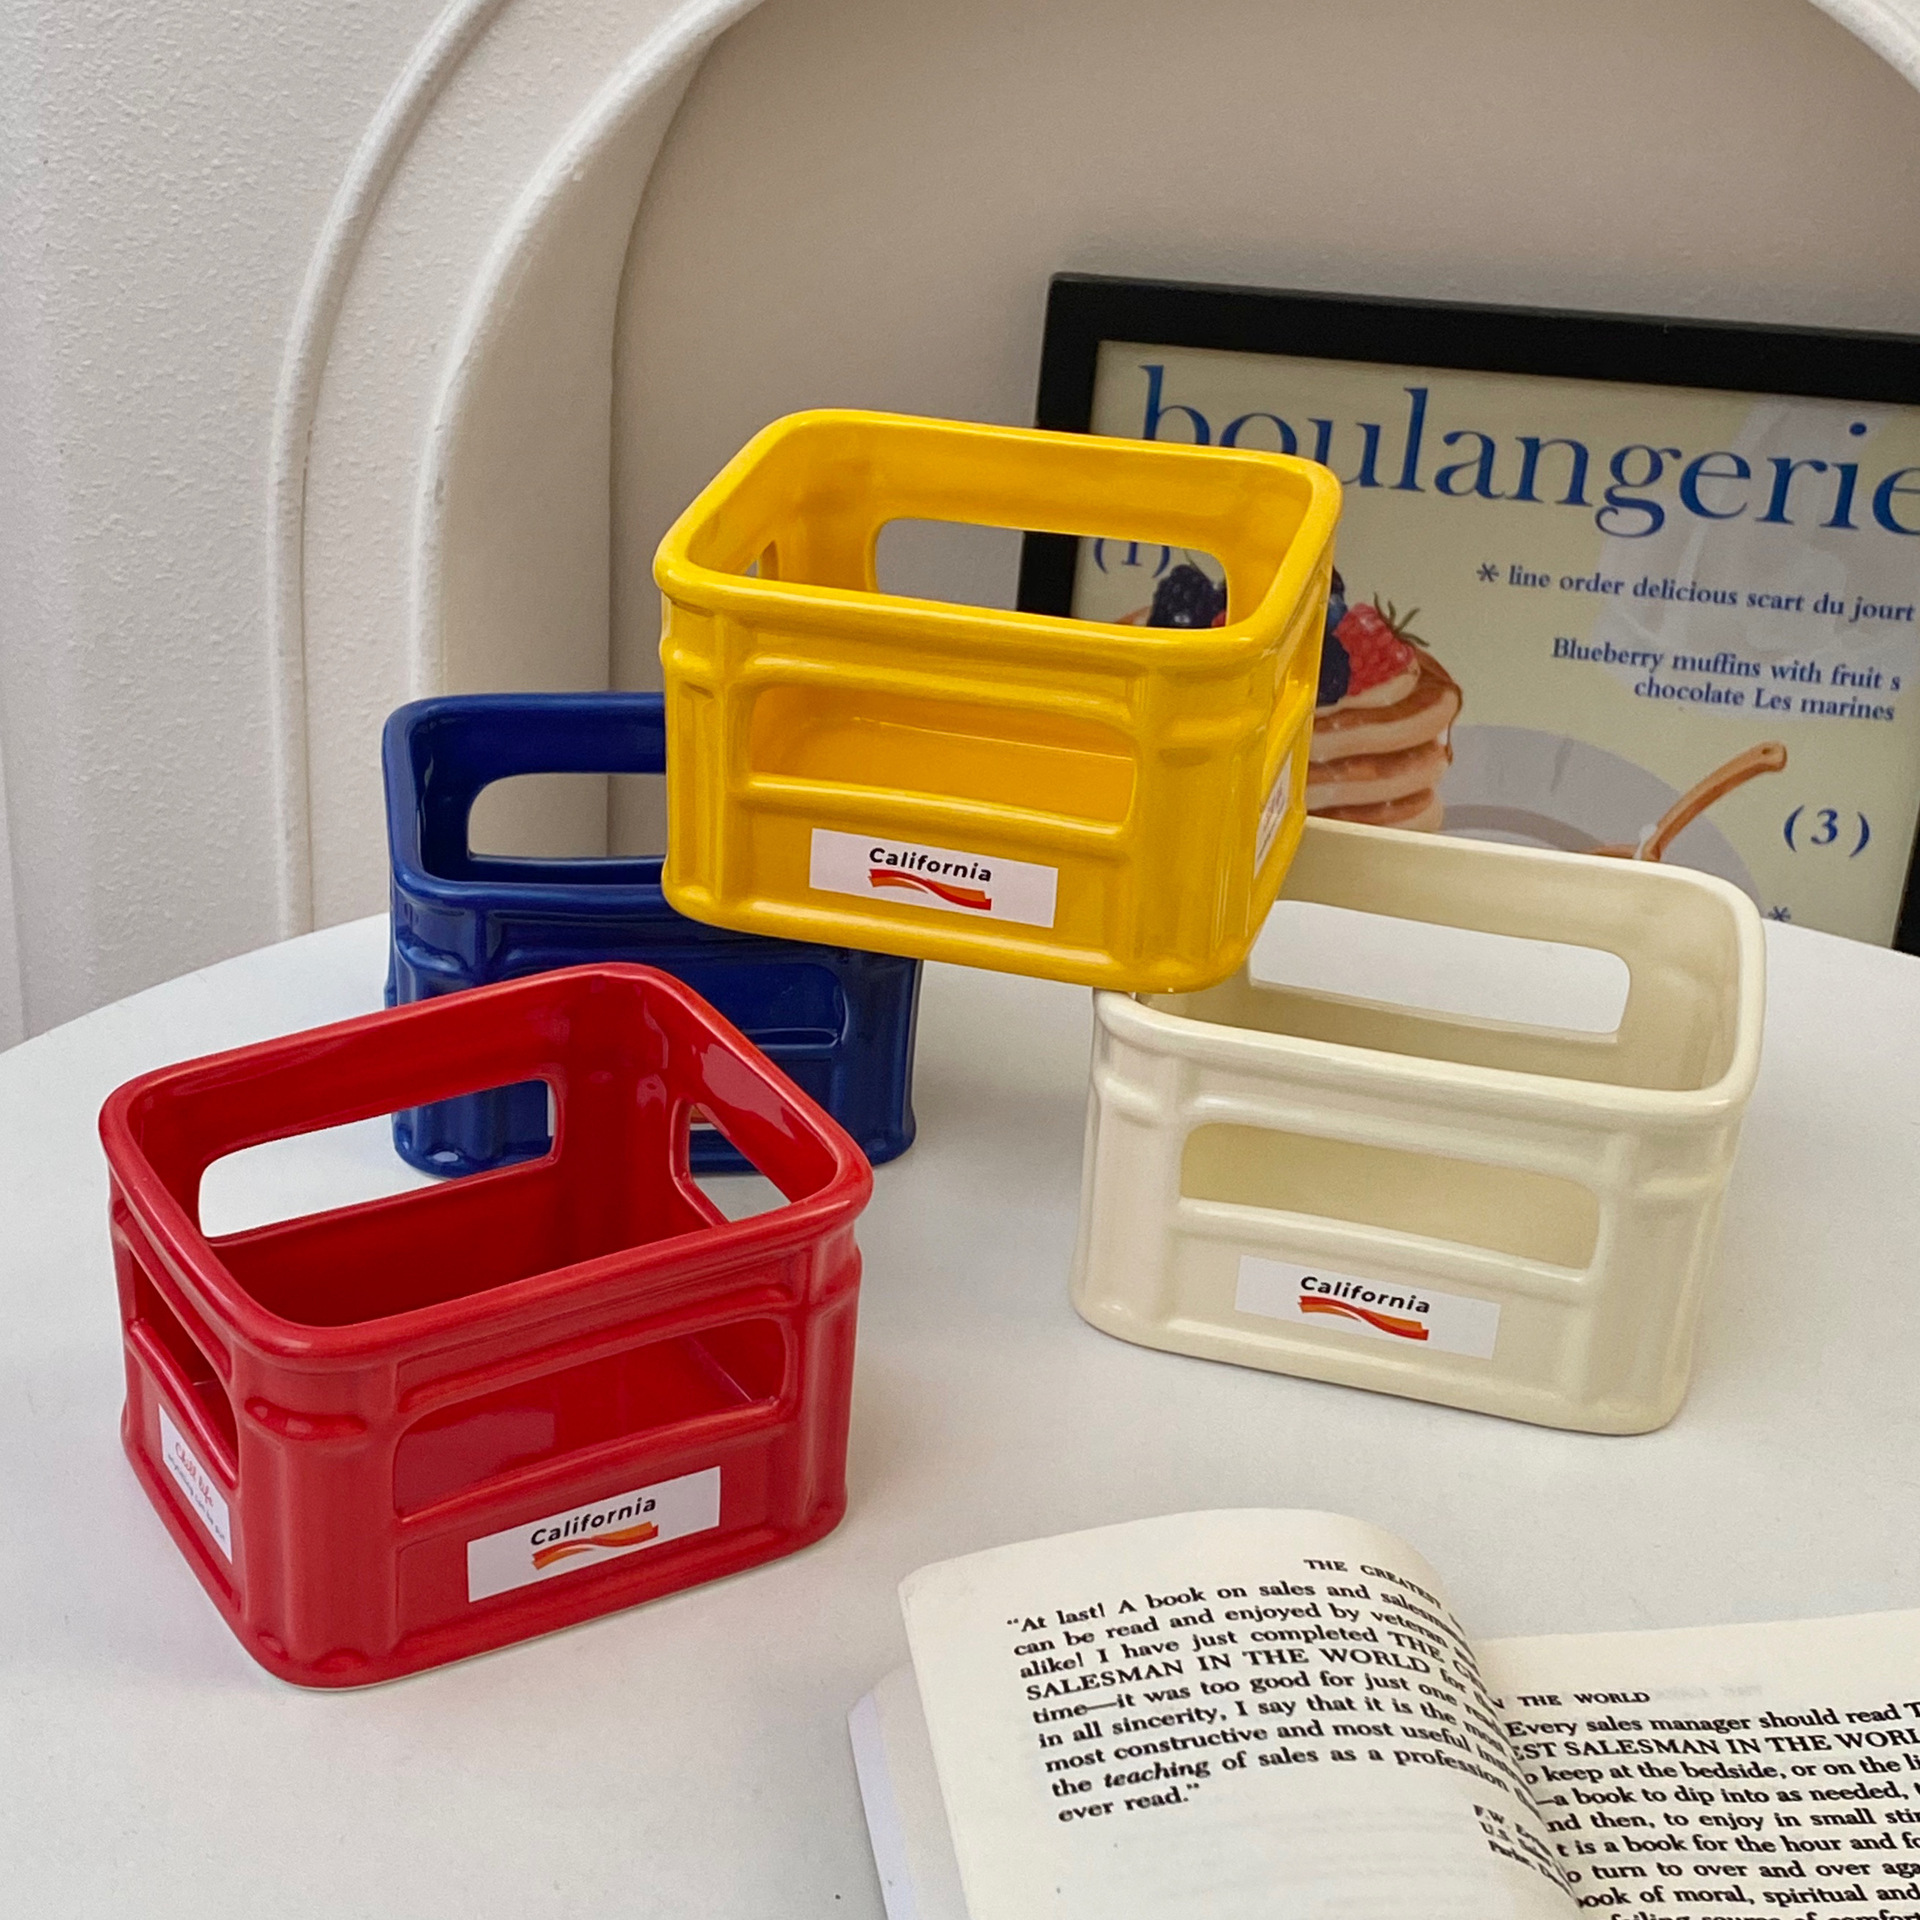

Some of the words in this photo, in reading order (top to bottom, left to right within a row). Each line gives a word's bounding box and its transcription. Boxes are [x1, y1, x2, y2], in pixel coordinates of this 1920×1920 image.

[1139, 365, 1920, 538] boulangerie
[1509, 565, 1550, 588] line
[1559, 572, 1625, 595] order
[1633, 577, 1737, 605] delicious
[1747, 594, 1804, 612] scart
[1813, 592, 1844, 615] du
[1849, 596, 1914, 623] jourt
[1553, 638, 1663, 674] Blueberry
[1672, 653, 1760, 677] muffins
[1771, 660, 1821, 683] with
[1831, 664, 1882, 689] fruit
[1890, 677, 1900, 691] s
[1634, 676, 1744, 705] chocolate
[1755, 688, 1791, 710] Les
[1801, 696, 1894, 720] marines
[869, 848, 991, 882] California
[1301, 1276, 1430, 1313] California
[530, 1497, 657, 1546] California
[1303, 1559, 1348, 1572] THE
[1056, 1603, 1105, 1625] last!
[1118, 1600, 1137, 1614] A
[1145, 1587, 1206, 1609] book
[1217, 1588, 1247, 1599] on
[1259, 1581, 1316, 1596] sales
[1327, 1584, 1371, 1599] and
[1014, 1640, 1055, 1656] can
[1063, 1631, 1094, 1646] be
[1106, 1616, 1159, 1638] read
[1170, 1608, 1215, 1628] and
[1225, 1602, 1322, 1622] enjoyed
[1328, 1603, 1359, 1622] by
[1020, 1652, 1083, 1678] alike!
[1097, 1649, 1109, 1663] I
[1121, 1642, 1179, 1658] have
[1193, 1631, 1237, 1652] just
[1251, 1624, 1379, 1643] completed
[1387, 1631, 1445, 1663] THE
[1026, 1659, 1184, 1700] SALESMAN
[1197, 1653, 1231, 1671] IN
[1242, 1649, 1309, 1665] THE
[1319, 1648, 1430, 1673] WORLD
[1440, 1668, 1466, 1693] for
[1143, 1687, 1190, 1703] was
[1200, 1681, 1240, 1695] too
[1250, 1671, 1311, 1693] good
[1320, 1670, 1354, 1686] for
[1365, 1673, 1410, 1691] just
[1418, 1684, 1457, 1706] one
[1517, 1695, 1562, 1707] THE
[1573, 1692, 1650, 1704] WORLD
[1039, 1734, 1063, 1748] in
[1073, 1721, 1103, 1741] all
[1112, 1708, 1226, 1735] sincerity,
[1235, 1701, 1248, 1716] I
[1258, 1701, 1296, 1716] say
[1307, 1694, 1356, 1711] that
[1365, 1696, 1384, 1711] it
[1392, 1698, 1413, 1714] is
[1420, 1702, 1457, 1725] the
[1504, 1721, 1577, 1737] Every
[1586, 1715, 1643, 1732] sales
[1649, 1719, 1751, 1734] manager
[1759, 1708, 1840, 1728] should
[1845, 1703, 1902, 1723] read
[1045, 1749, 1105, 1772] most
[1112, 1723, 1267, 1760] constructive
[1277, 1719, 1324, 1738] and
[1332, 1723, 1394, 1736] most
[1401, 1726, 1471, 1752] useful
[1564, 1739, 1720, 1756] SALESMAN
[1725, 1738, 1761, 1754] IN
[1764, 1735, 1832, 1752] THE
[1834, 1728, 1920, 1749] WORL
[1052, 1779, 1092, 1797] the
[1104, 1761, 1211, 1789] teaching
[1222, 1750, 1246, 1770] of
[1258, 1746, 1319, 1766] sales
[1330, 1750, 1357, 1761] as
[1368, 1749, 1384, 1761] a
[1393, 1749, 1509, 1792] profession
[1541, 1765, 1603, 1783] keep
[1609, 1765, 1634, 1778] at
[1637, 1761, 1678, 1778] the
[1679, 1761, 1787, 1779] bedside,
[1791, 1765, 1817, 1776] or
[1823, 1764, 1856, 1775] on
[1859, 1756, 1901, 1773] the
[1571, 1786, 1637, 1804] book
[1641, 1789, 1667, 1802] to
[1674, 1785, 1715, 1806] dip
[1720, 1788, 1770, 1803] into
[1776, 1790, 1803, 1802] as
[1809, 1781, 1909, 1801] needed,
[1059, 1802, 1113, 1822] ever
[1547, 1813, 1582, 1832] nd
[1590, 1811, 1655, 1828] then,
[1663, 1813, 1689, 1826] to
[1699, 1812, 1763, 1831] enjoy
[1774, 1812, 1802, 1827] in
[1810, 1808, 1877, 1826] small
[1575, 1840, 1596, 1855] is
[1604, 1842, 1620, 1853] a
[1621, 1834, 1688, 1852] book
[1692, 1834, 1728, 1851] for
[1735, 1835, 1776, 1853] the
[1779, 1835, 1841, 1852] hour
[1850, 1832, 1898, 1850] and
[1592, 1865, 1647, 1879] turn
[1656, 1862, 1683, 1876] to
[1693, 1865, 1747, 1877] over
[1759, 1860, 1806, 1878] and
[1815, 1864, 1870, 1876] over
[1882, 1863, 1920, 1879] aga
[1639, 1885, 1665, 1903] of
[1673, 1884, 1755, 1905] moral,
[1763, 1884, 1868, 1908] spiritual
[1876, 1883, 1920, 1901] and
